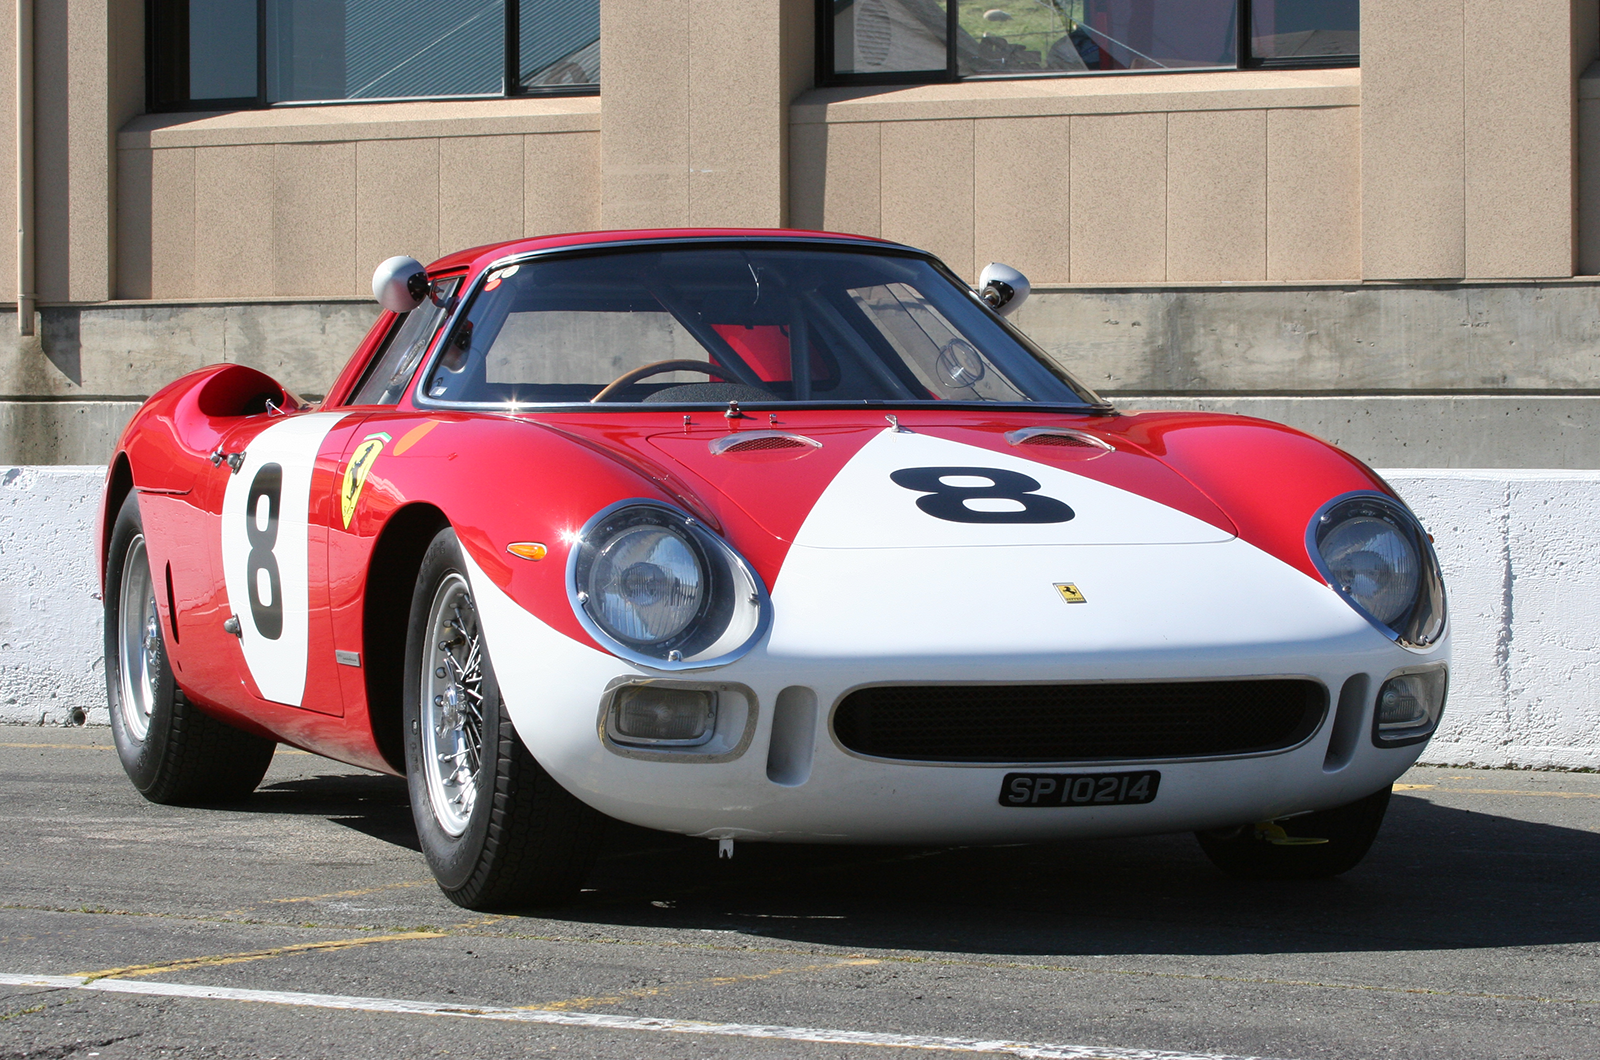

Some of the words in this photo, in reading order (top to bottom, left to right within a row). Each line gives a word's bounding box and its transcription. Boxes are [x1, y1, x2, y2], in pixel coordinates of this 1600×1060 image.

[889, 466, 1076, 524] 8
[246, 462, 283, 640] 8
[1008, 777, 1057, 803] SP
[1061, 775, 1151, 803] 10214
